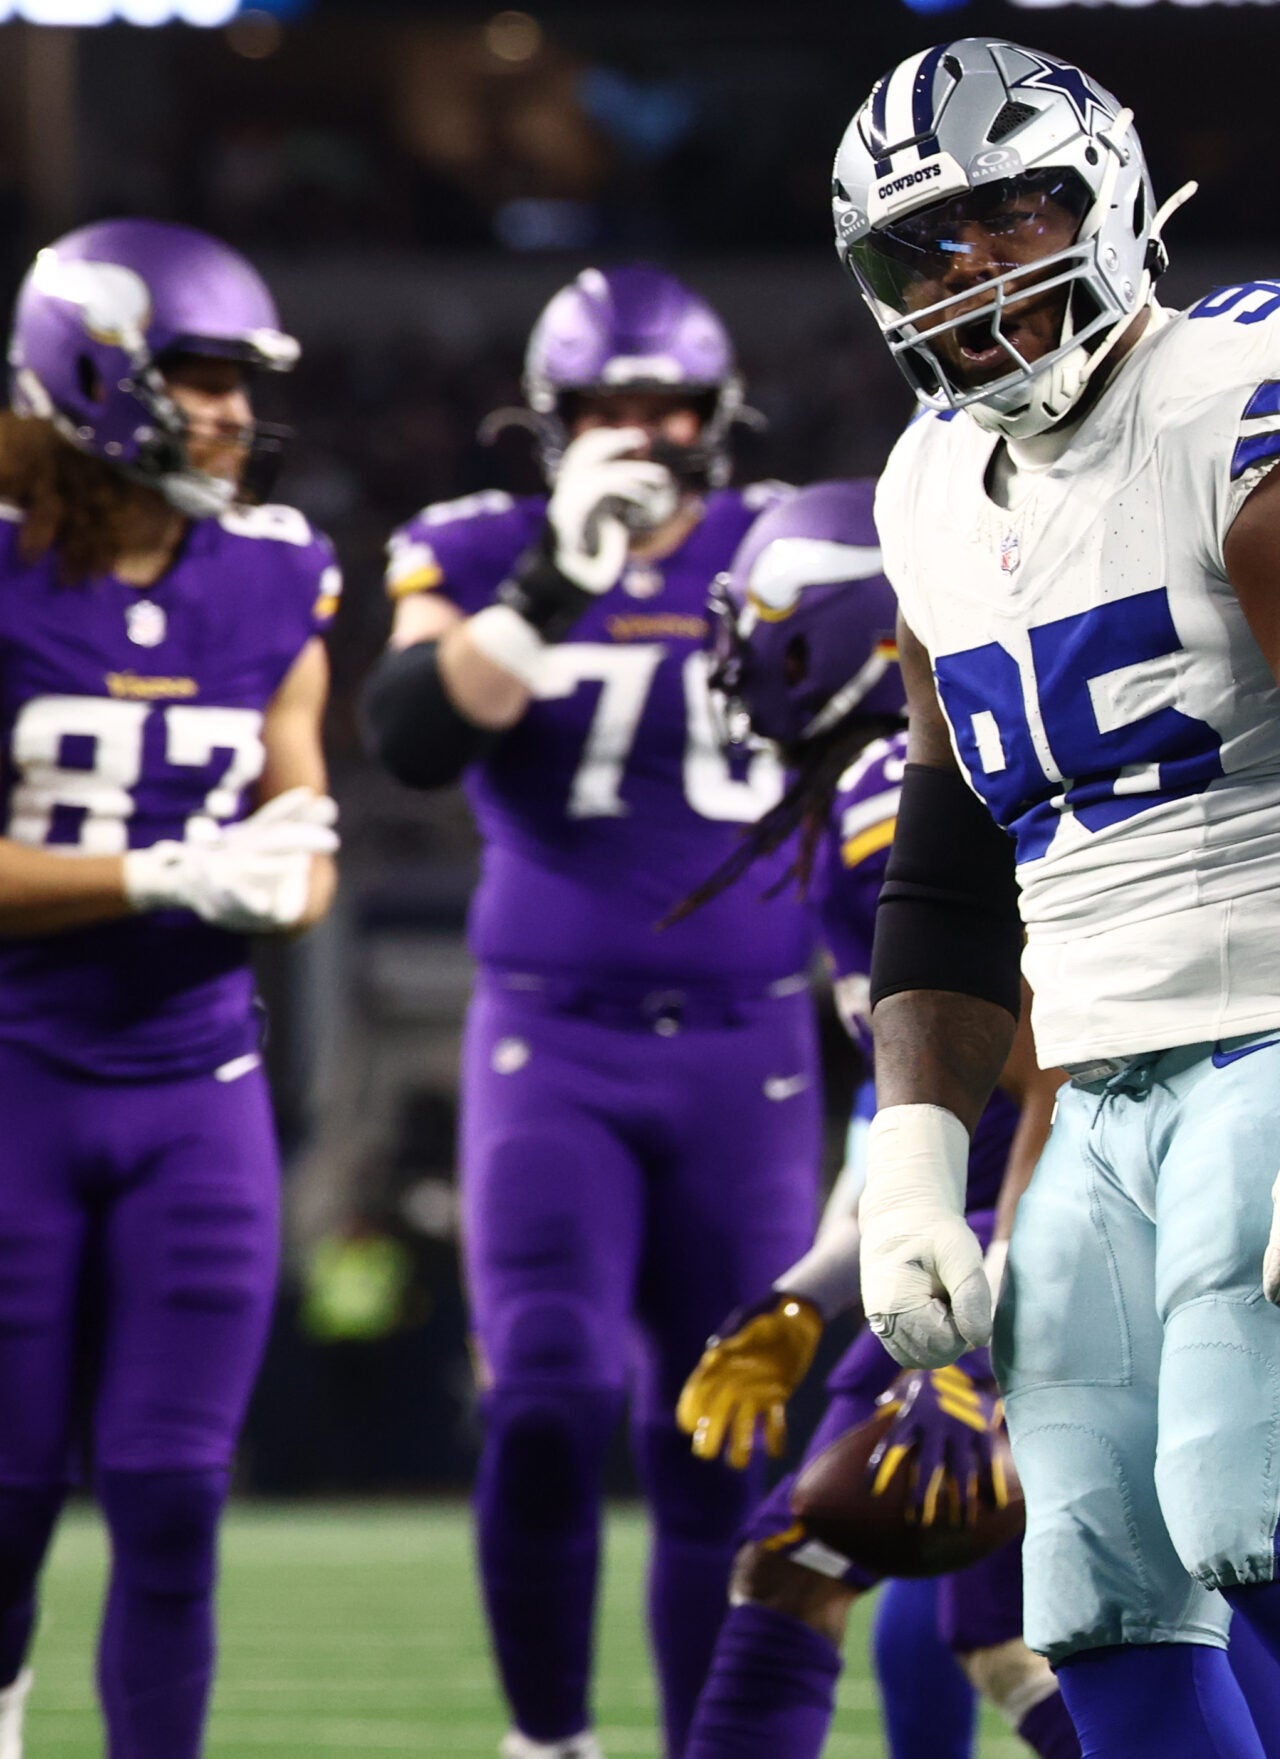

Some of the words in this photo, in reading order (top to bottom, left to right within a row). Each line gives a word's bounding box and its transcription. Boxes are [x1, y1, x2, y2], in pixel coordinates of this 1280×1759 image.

[878, 164, 942, 200] COWBOYS
[12, 693, 266, 855] 87
[934, 586, 1225, 865] 95
